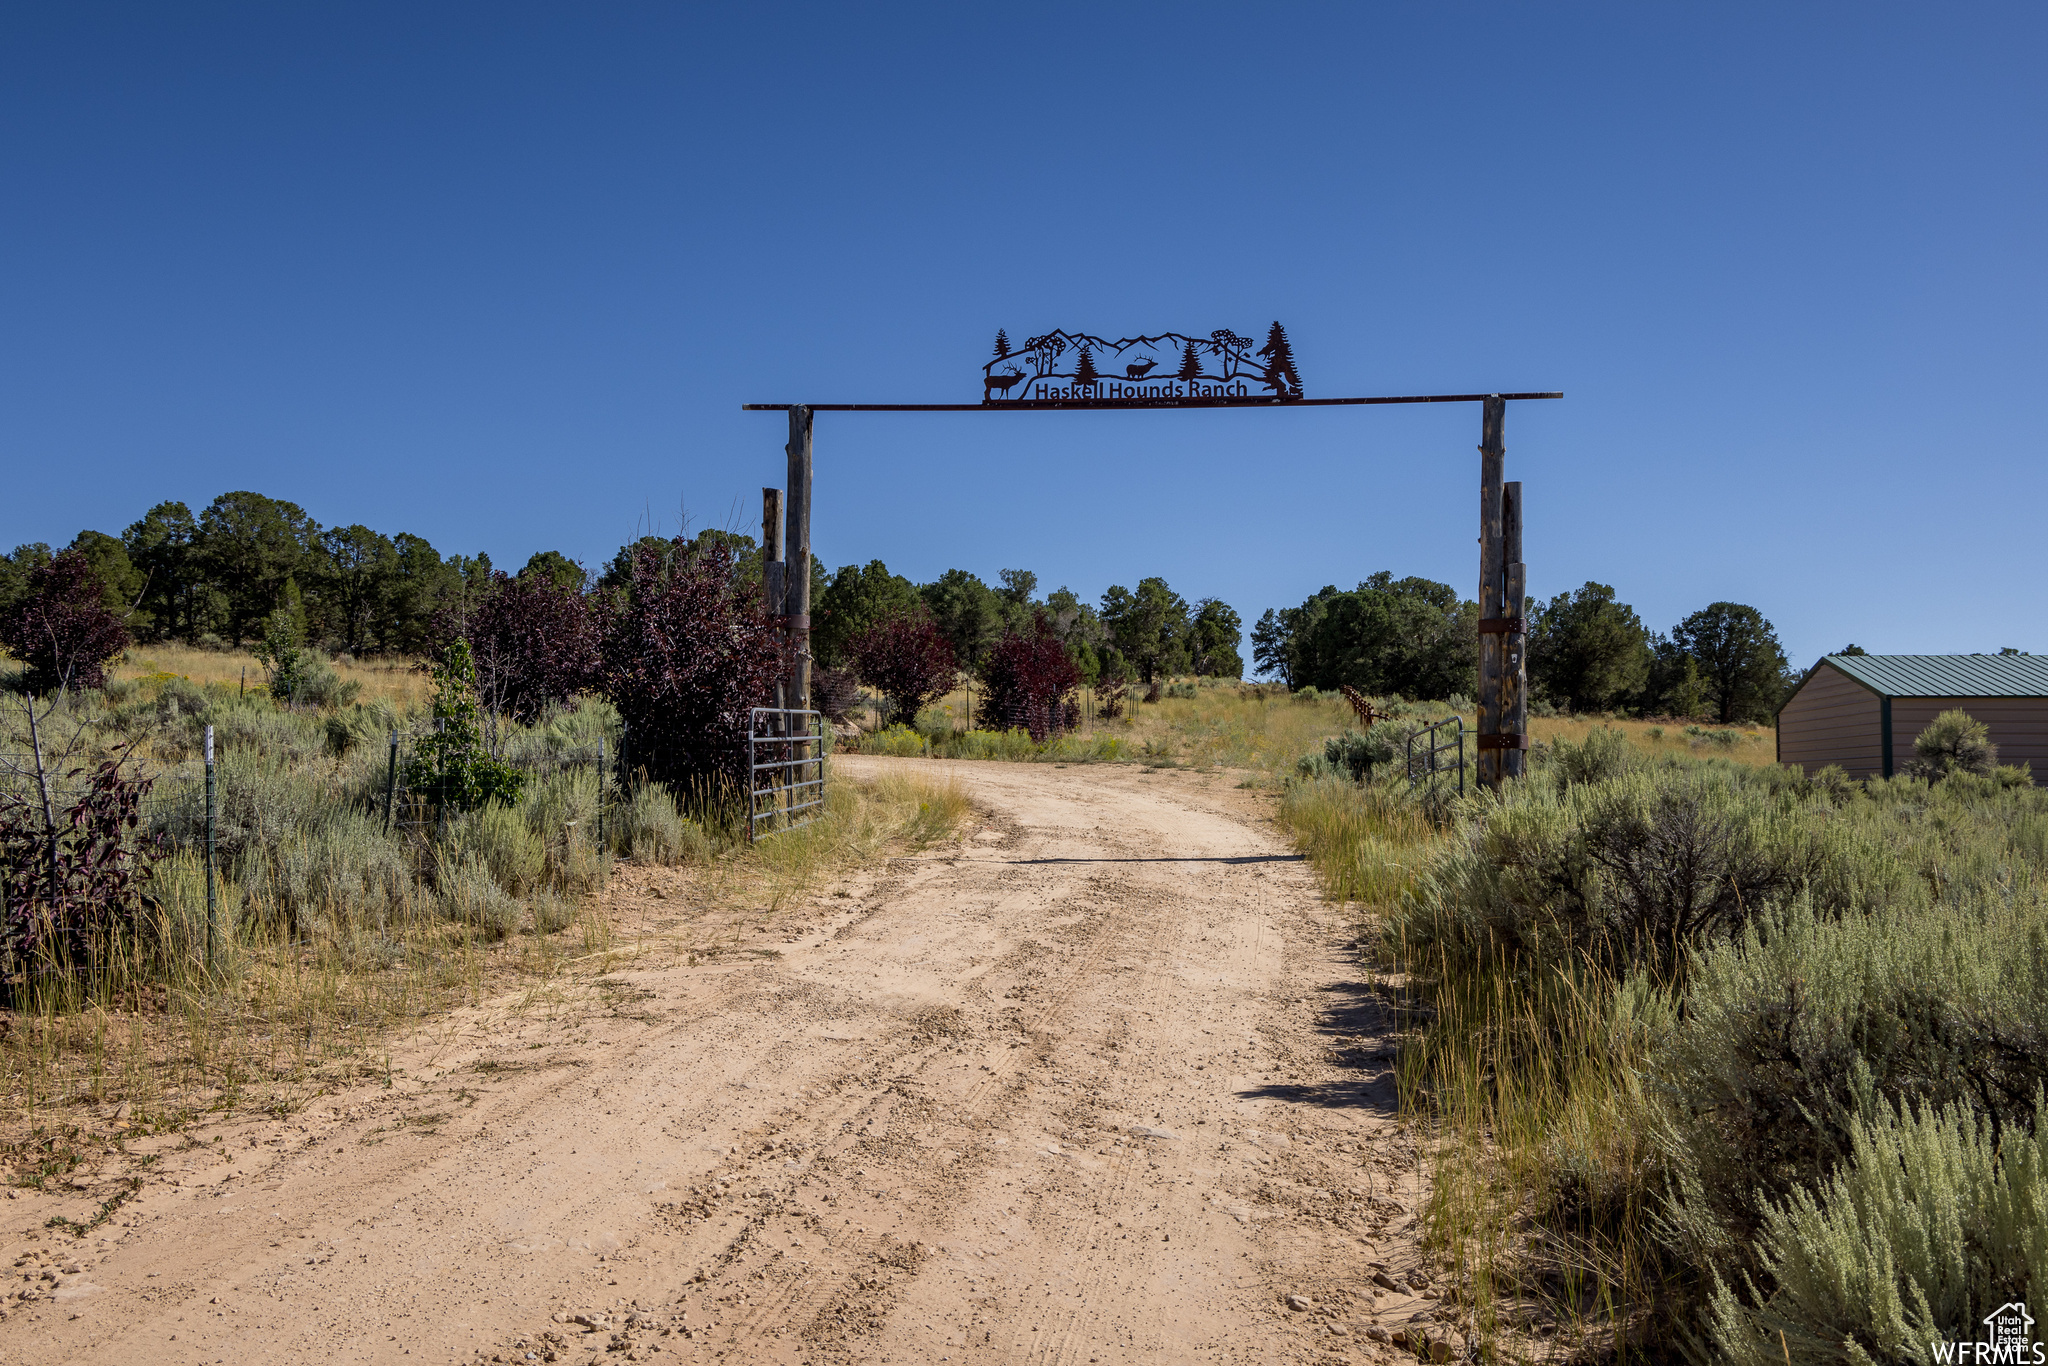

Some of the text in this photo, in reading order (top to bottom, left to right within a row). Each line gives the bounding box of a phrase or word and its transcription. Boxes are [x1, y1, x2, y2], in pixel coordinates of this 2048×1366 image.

[1035, 380, 1248, 399] Haskell Hounds Ranch
